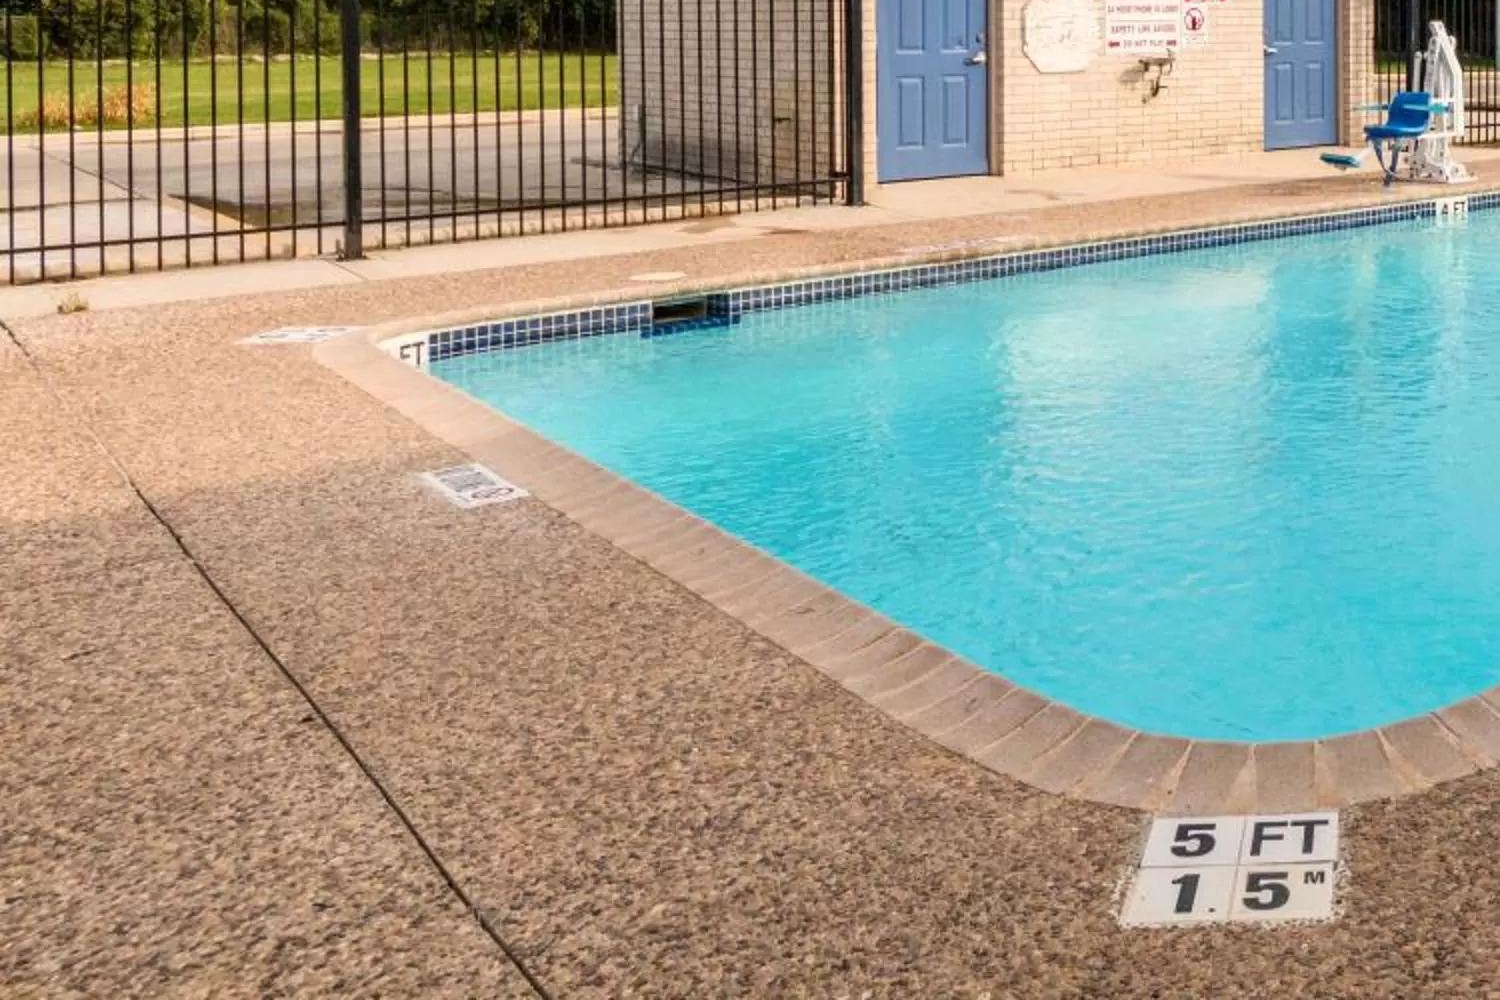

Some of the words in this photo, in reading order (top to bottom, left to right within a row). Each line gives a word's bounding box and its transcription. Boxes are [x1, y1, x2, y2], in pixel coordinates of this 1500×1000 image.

[1441, 202, 1449, 215] 4
[1453, 201, 1465, 216] FT
[1170, 823, 1217, 857] 5
[1249, 819, 1329, 857] FT
